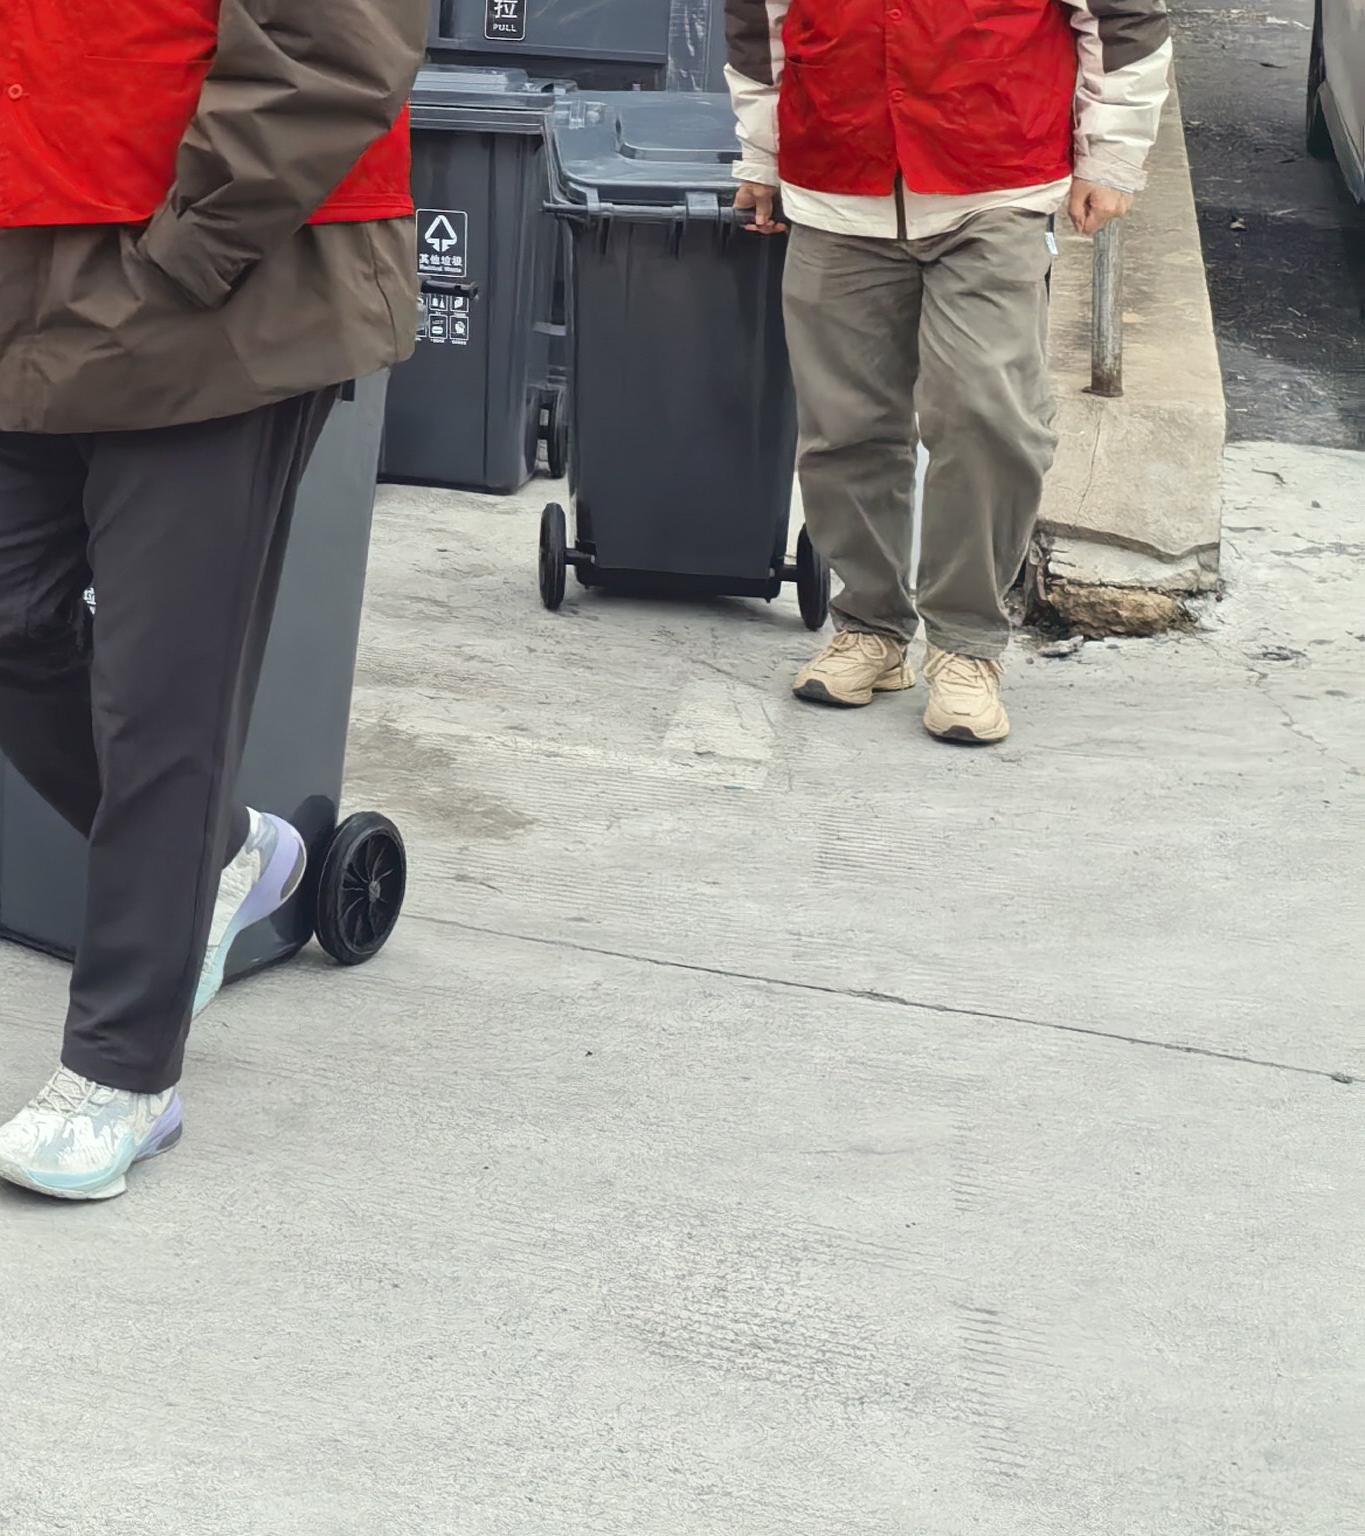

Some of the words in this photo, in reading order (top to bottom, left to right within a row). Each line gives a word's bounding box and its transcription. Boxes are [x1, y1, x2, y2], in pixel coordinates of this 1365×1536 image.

[493, 23, 517, 33] PULL
[419, 253, 463, 267] 其他垃圾
